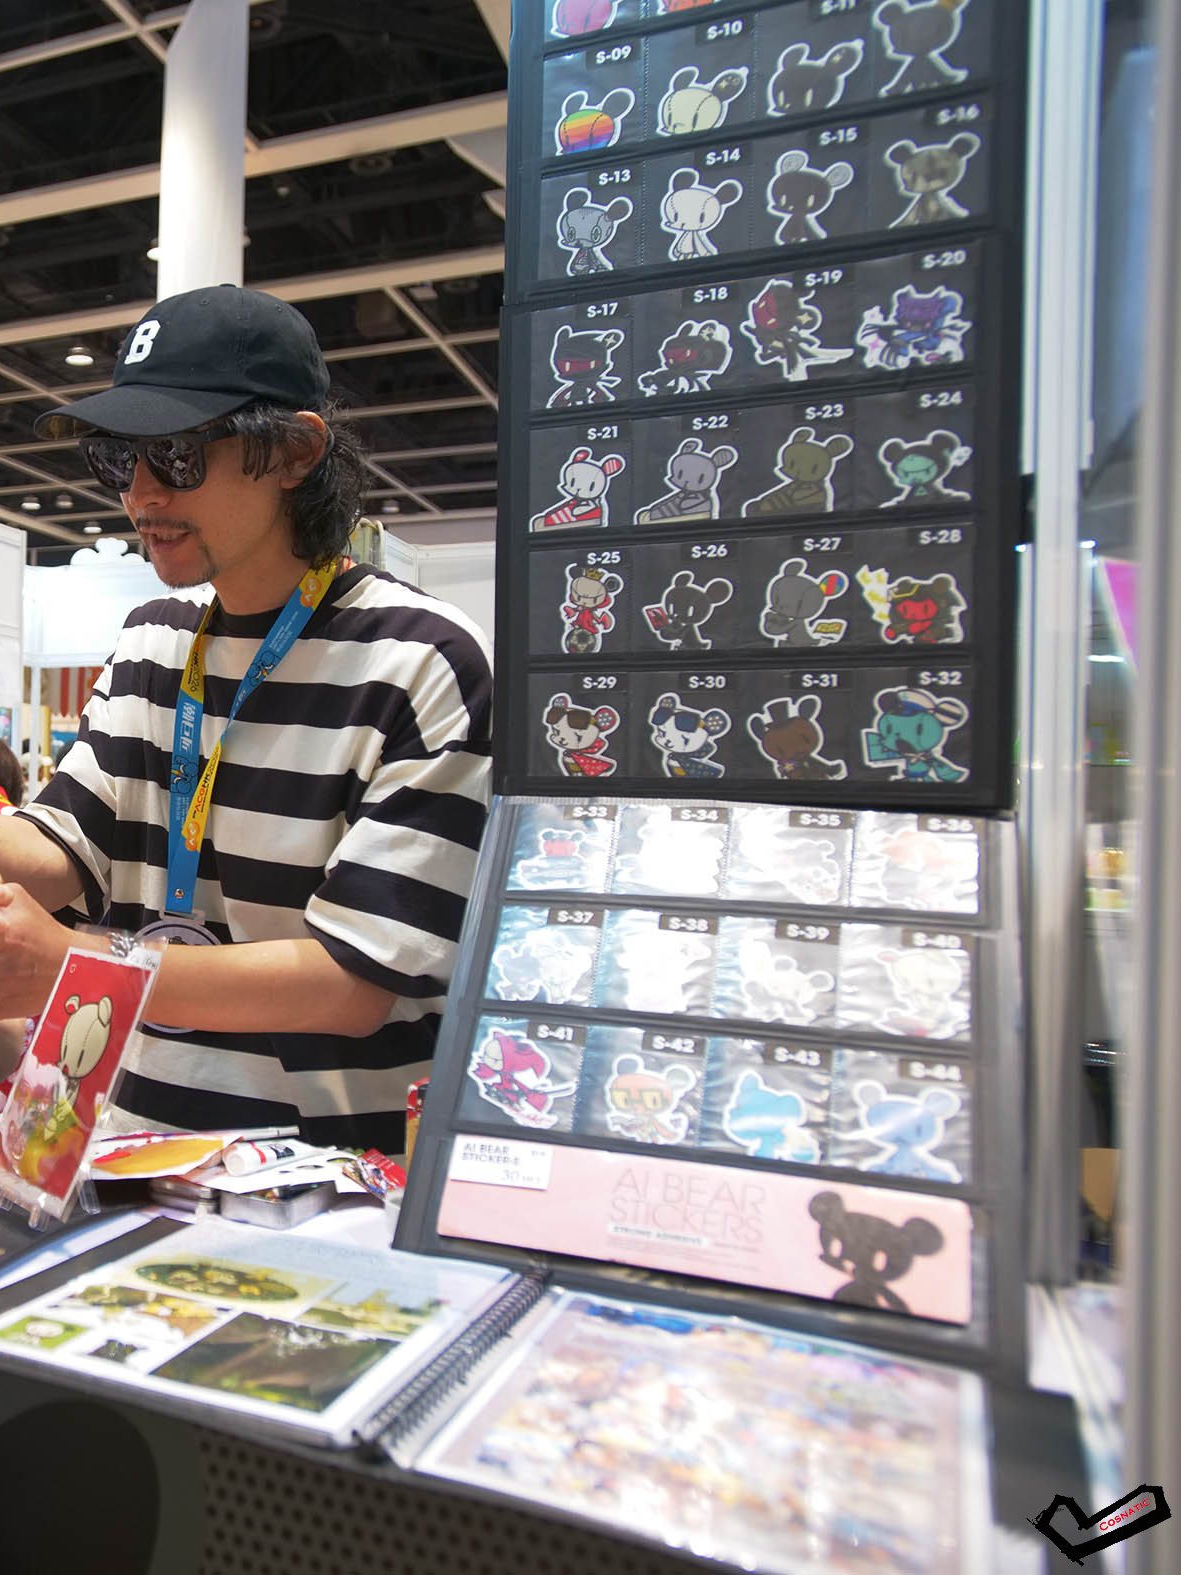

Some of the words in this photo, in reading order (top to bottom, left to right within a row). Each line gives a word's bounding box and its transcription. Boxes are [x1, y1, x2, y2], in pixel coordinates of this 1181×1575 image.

[707, 21, 743, 39] S-10
[596, 45, 632, 63] S-09
[936, 104, 980, 124] S-16
[819, 128, 857, 145] S-15
[706, 149, 741, 165] S-14
[598, 169, 631, 185] S-13
[922, 250, 966, 268] S-20
[805, 270, 843, 287] S-19
[694, 287, 728, 303] S-18
[587, 302, 618, 318] S-17
[124, 319, 161, 365] B
[920, 390, 963, 408] S-24
[805, 404, 844, 420] S-23
[692, 415, 729, 430] S-22
[587, 425, 619, 441] S-21
[803, 536, 842, 552] S-27
[919, 528, 962, 545] S-28
[586, 551, 621, 565] S-25
[691, 543, 728, 559] S-26
[582, 676, 617, 690] S-29
[689, 674, 726, 689] S-30
[802, 673, 839, 688] S-31
[919, 671, 962, 686] S-32
[572, 805, 608, 819] S-33
[680, 809, 719, 823] S-34
[799, 812, 842, 827] S-35
[927, 817, 974, 833] S-36
[556, 910, 594, 924] S-37
[668, 917, 709, 932] S-38
[786, 924, 831, 941] S-39
[537, 1025, 574, 1041] S-41
[652, 1036, 695, 1053] S-42
[774, 1048, 821, 1066] S-43
[908, 1061, 962, 1081] S-44
[613, 1167, 650, 1202] AI
[663, 1172, 767, 1216] BEAR
[610, 1196, 764, 1245] STICKERS
